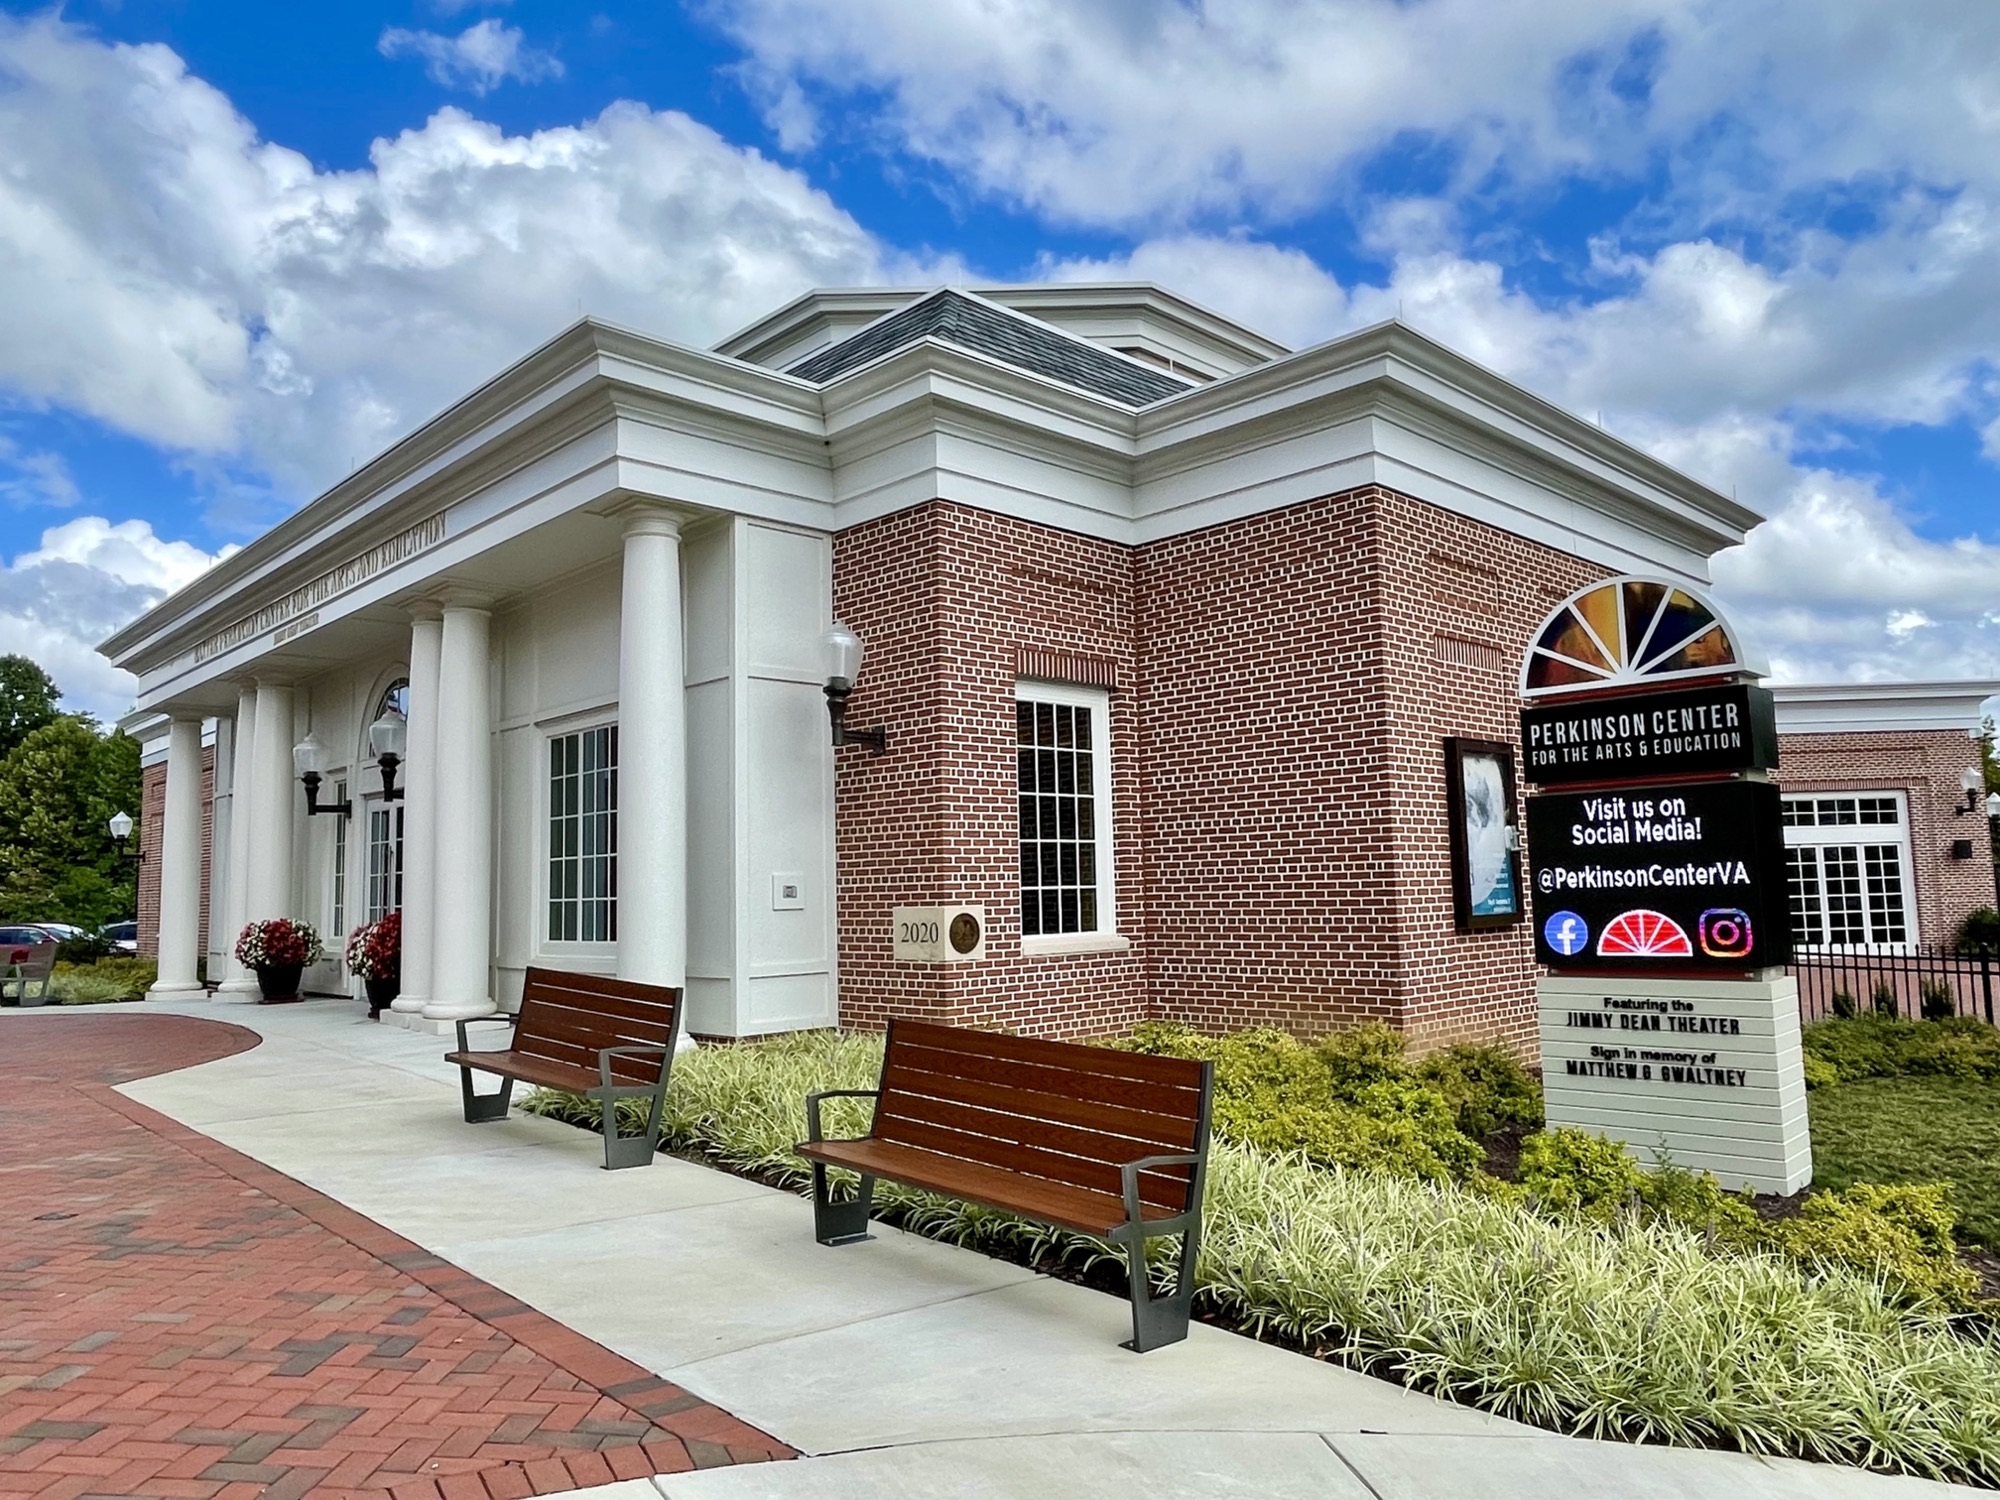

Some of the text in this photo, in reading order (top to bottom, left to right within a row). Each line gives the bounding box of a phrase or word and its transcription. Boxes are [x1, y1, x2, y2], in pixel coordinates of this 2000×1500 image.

[292, 586, 309, 615] FOR
[310, 575, 329, 605] THE
[331, 561, 355, 595] ARTS
[357, 548, 378, 582] AND
[382, 510, 446, 569] EDUCATION
[1530, 703, 1739, 747] PERKINSON CENTER
[1532, 732, 1740, 766] FOR THE ARTS & EDUCATION
[1582, 797, 1686, 821] Visit us on
[1572, 817, 1702, 845] Social Media!
[1538, 861, 1750, 893] @PerkinsonCenterVA
[901, 922, 939, 943] 2020
[1603, 997, 1694, 1013] Featuring the
[1566, 1012, 1740, 1035] JIMMY DEAN THEATER
[1590, 1045, 1717, 1065] Sign in memory of
[1566, 1060, 1637, 1079] MATTHEW
[1661, 1065, 1746, 1086] GWALTNEY
